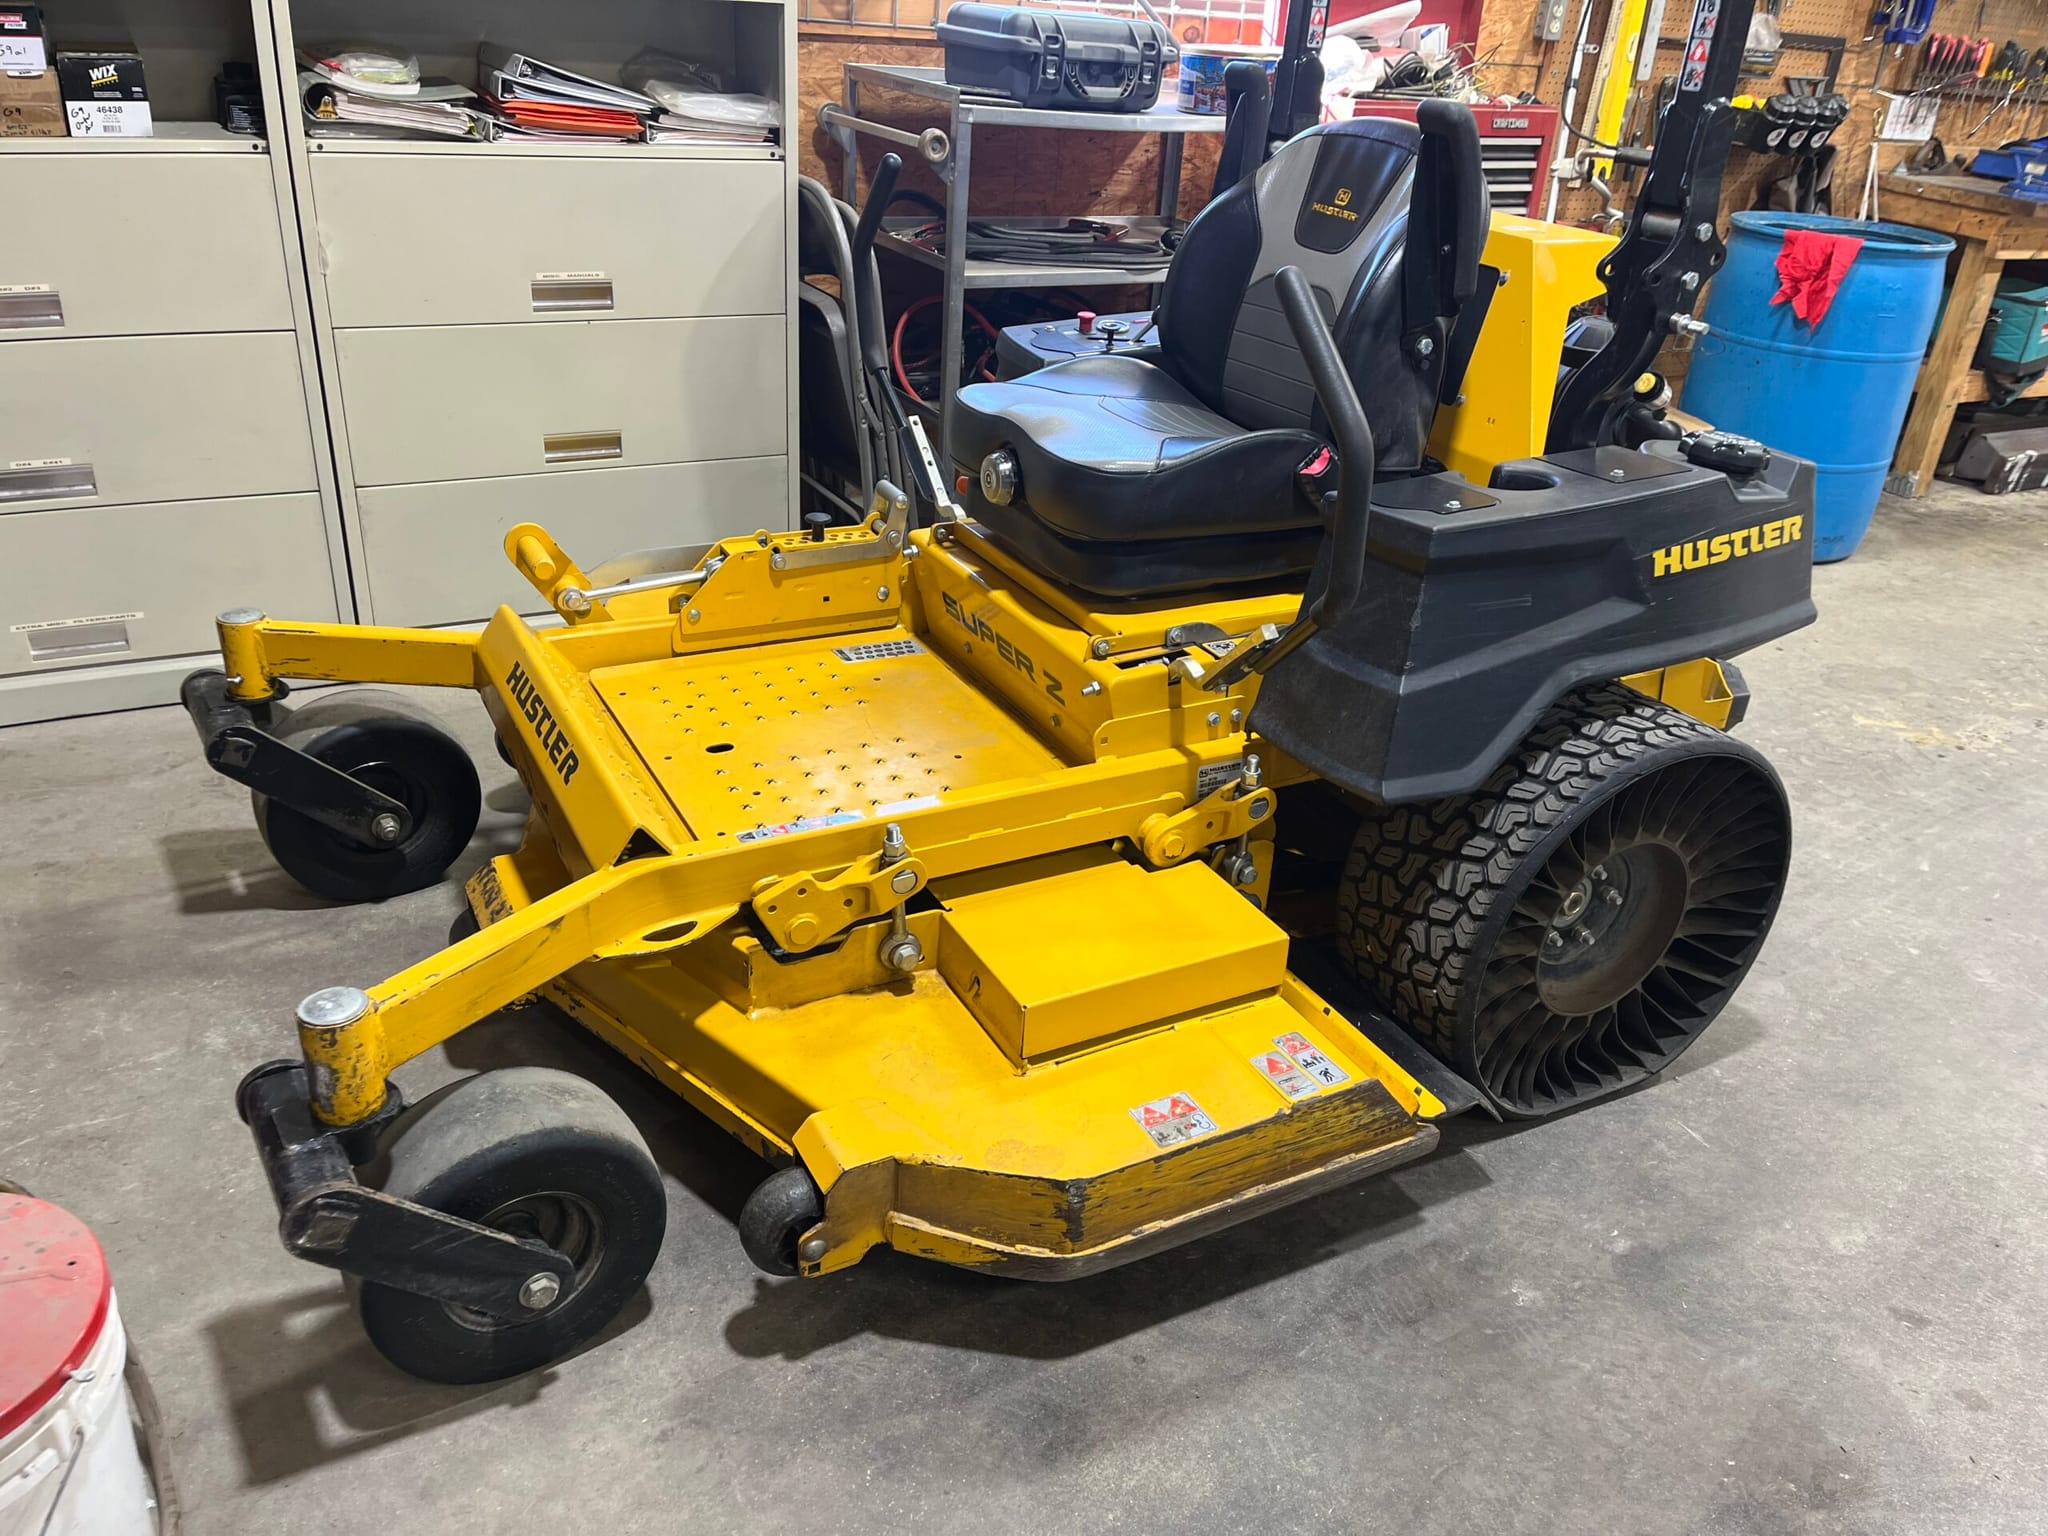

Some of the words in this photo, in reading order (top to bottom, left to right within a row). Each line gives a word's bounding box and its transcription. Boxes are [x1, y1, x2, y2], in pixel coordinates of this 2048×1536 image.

[88, 64, 118, 81] WIX
[96, 105, 123, 114] 46438
[1311, 201, 1360, 222] HUSTLER
[1652, 514, 1804, 577] HUSTLER
[942, 592, 1037, 685] SUPER
[1043, 668, 1066, 707] Z
[505, 660, 580, 787] HUSTLER
